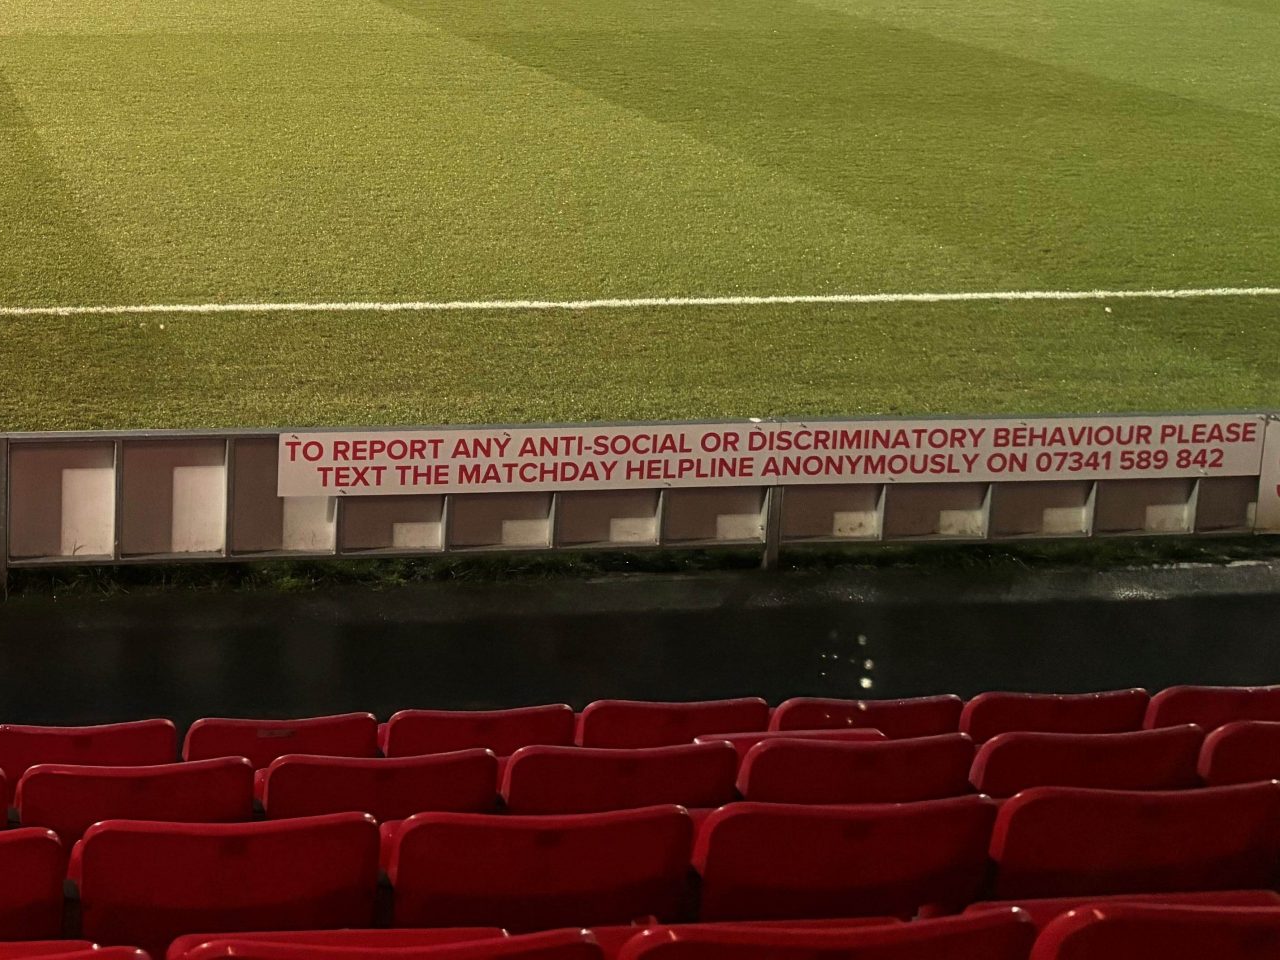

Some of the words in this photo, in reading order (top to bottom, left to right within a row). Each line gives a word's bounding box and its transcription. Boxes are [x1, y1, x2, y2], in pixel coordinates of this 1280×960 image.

[285, 441, 324, 462] TO
[333, 438, 444, 461] REPORT
[451, 437, 511, 459] ANY
[518, 433, 692, 457] ANTI-SOCIAL
[700, 431, 740, 453] OR
[748, 427, 986, 452] DISCRIMINATORY
[993, 424, 1153, 448] BEHAVIOUR
[1160, 422, 1257, 444] PLEASE
[317, 465, 387, 487] TEXT
[395, 464, 449, 486] THE
[458, 460, 618, 484] MATCHDAY
[625, 456, 754, 480] HELPLINE
[761, 452, 979, 477] ANONYMOUSLY
[987, 452, 1027, 473] ON
[1035, 450, 1111, 472] 07341
[1120, 449, 1168, 470] 589
[1176, 448, 1224, 469] 842
